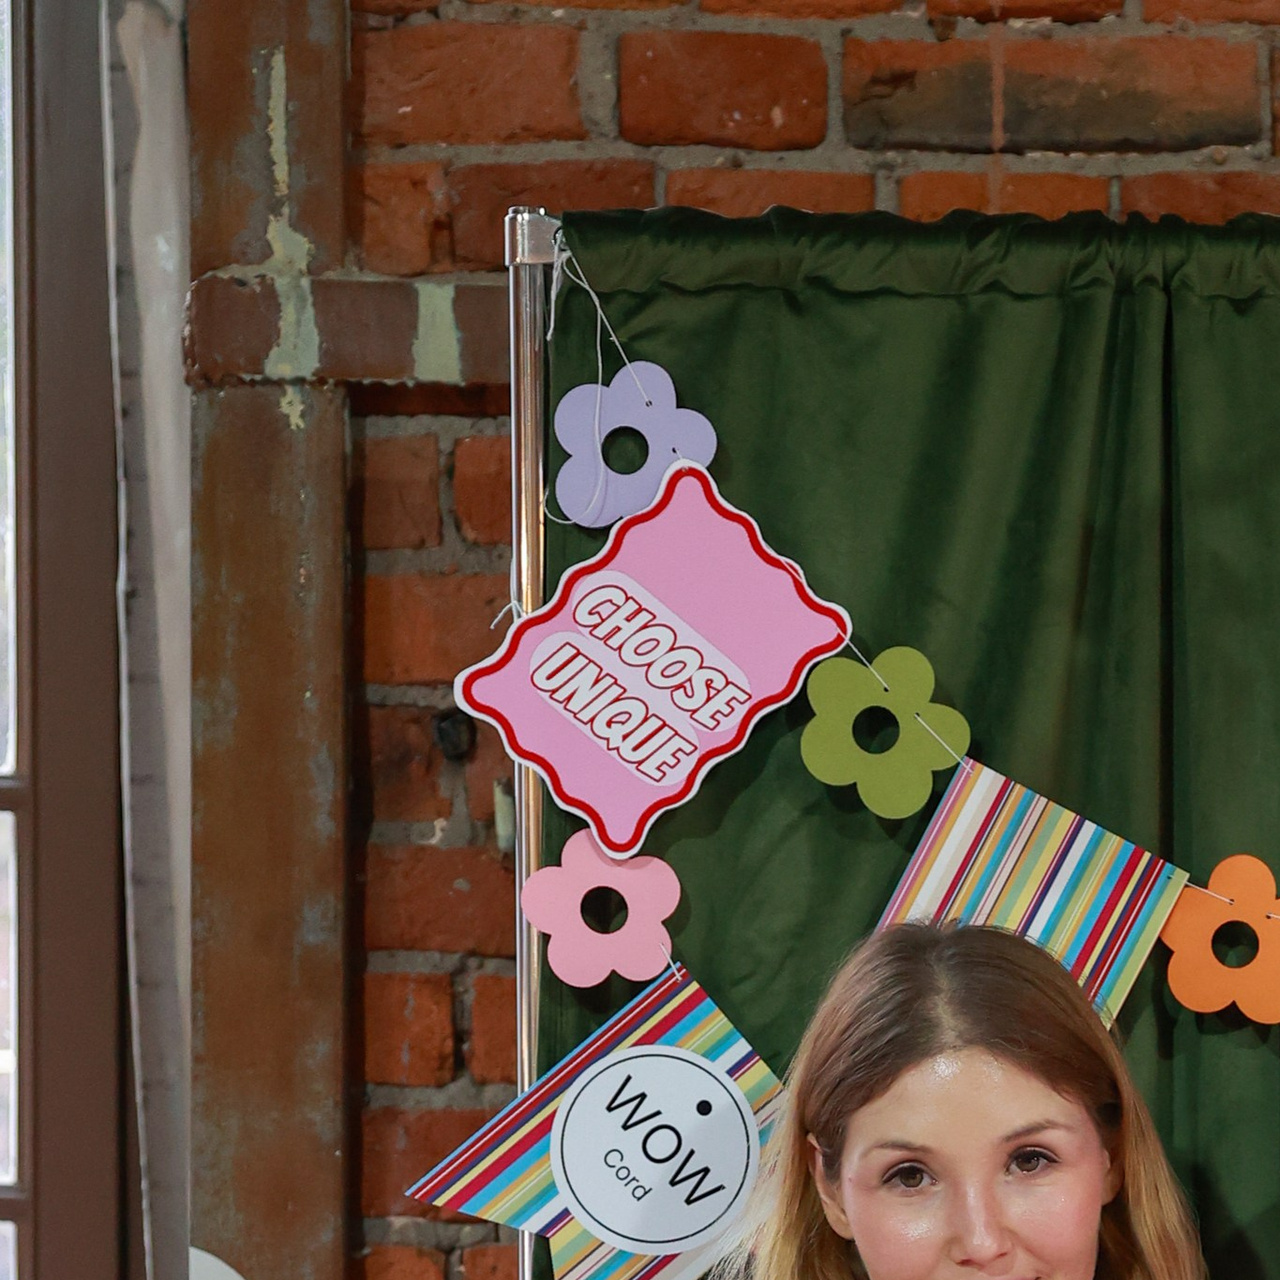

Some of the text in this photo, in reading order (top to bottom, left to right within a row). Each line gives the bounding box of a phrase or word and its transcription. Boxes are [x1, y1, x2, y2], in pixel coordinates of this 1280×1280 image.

[530, 642, 698, 782] UNIQUE
[573, 584, 751, 731] CHOOSE
[603, 1148, 653, 1202] Cord
[605, 1074, 726, 1206] WOW
